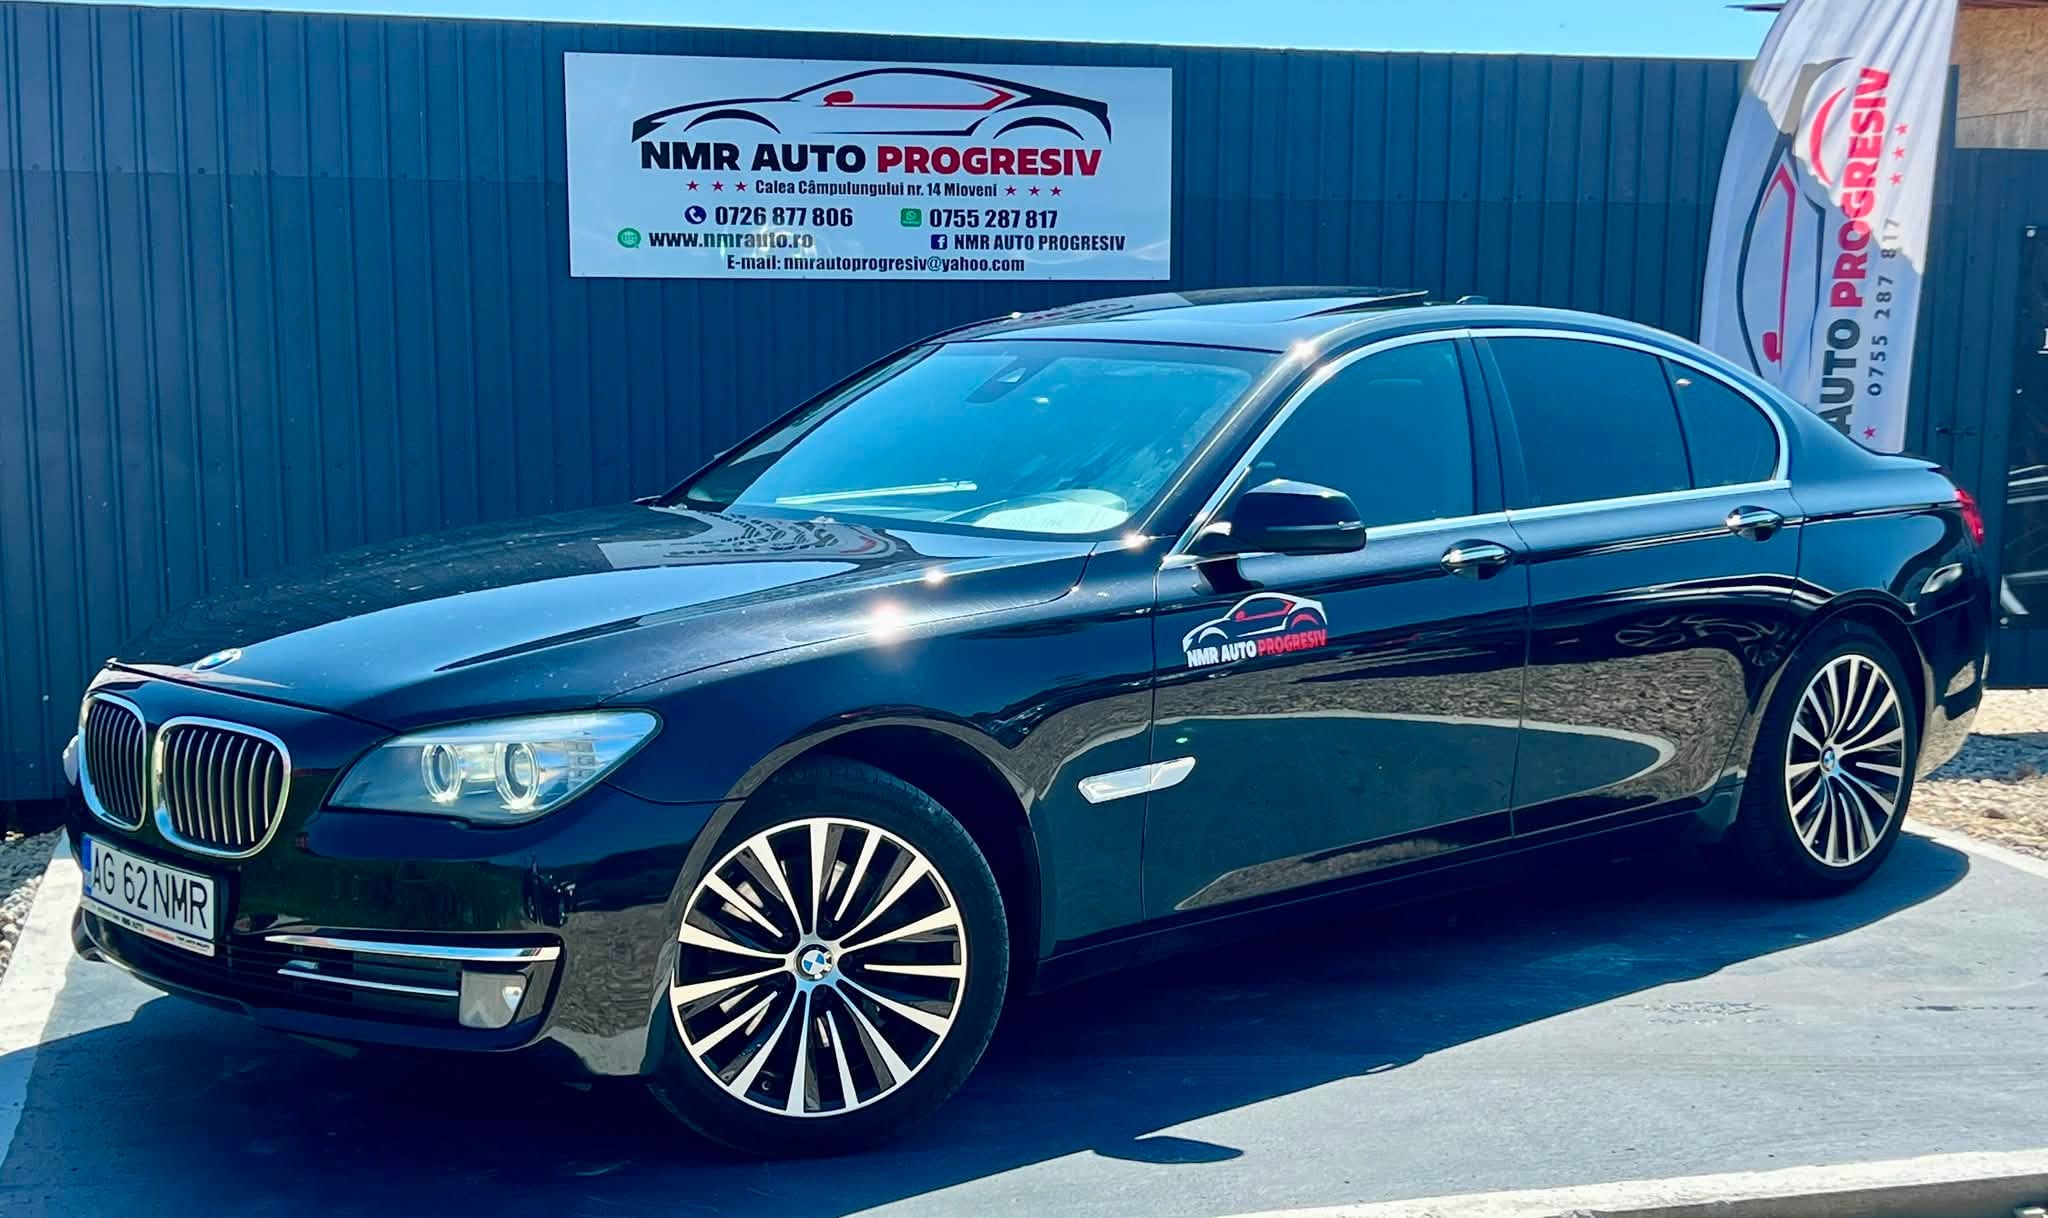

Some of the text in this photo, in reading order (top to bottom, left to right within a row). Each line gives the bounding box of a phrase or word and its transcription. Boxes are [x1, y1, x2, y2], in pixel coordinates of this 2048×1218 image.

[641, 141, 1103, 176] NMR AUTO PROGRESIV
[755, 180, 997, 197] Calea Câmpulungului nr. 14 Mioveni
[1830, 67, 1890, 307] PROGRESIV
[715, 206, 853, 227] 0726 877 806
[929, 208, 1058, 229] 0755 287 817
[649, 231, 814, 249] www.nmrauto.ro
[954, 235, 990, 250] NMR
[994, 235, 1034, 250] AUTO
[1039, 235, 1125, 251] PROGRESIV
[727, 254, 1025, 272] E-mail: nmrautoprogresiv@yahoo.com
[1867, 218, 1900, 396] 0755 287 817
[1187, 629, 1328, 668] NMR AUTO PROGRESIV
[93, 847, 115, 895] AG
